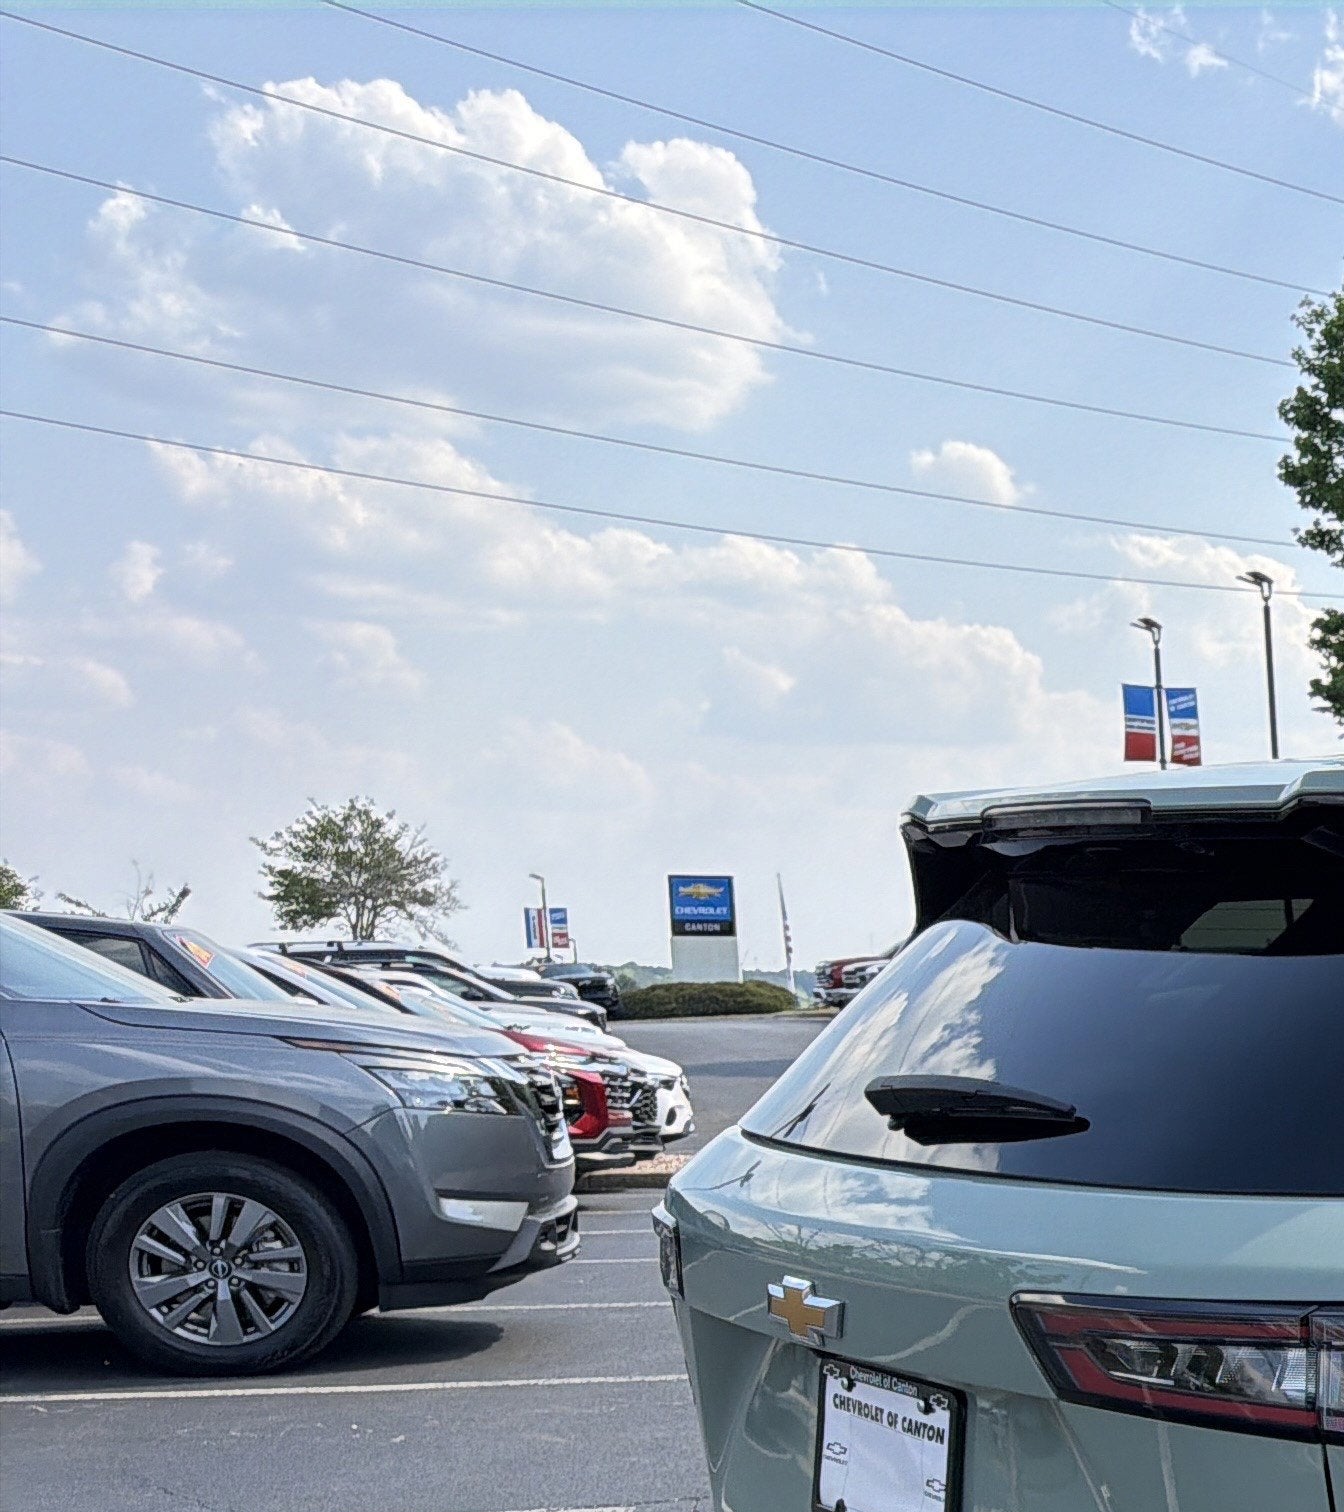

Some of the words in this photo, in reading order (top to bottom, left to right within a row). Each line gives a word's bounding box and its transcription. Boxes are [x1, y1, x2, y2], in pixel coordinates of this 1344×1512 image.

[675, 906, 728, 915] CHEVROLET
[684, 922, 721, 932] CANTON
[832, 1393, 884, 1424] CHEVROLET
[887, 1411, 898, 1429] OF
[901, 1416, 945, 1445] CANTON
